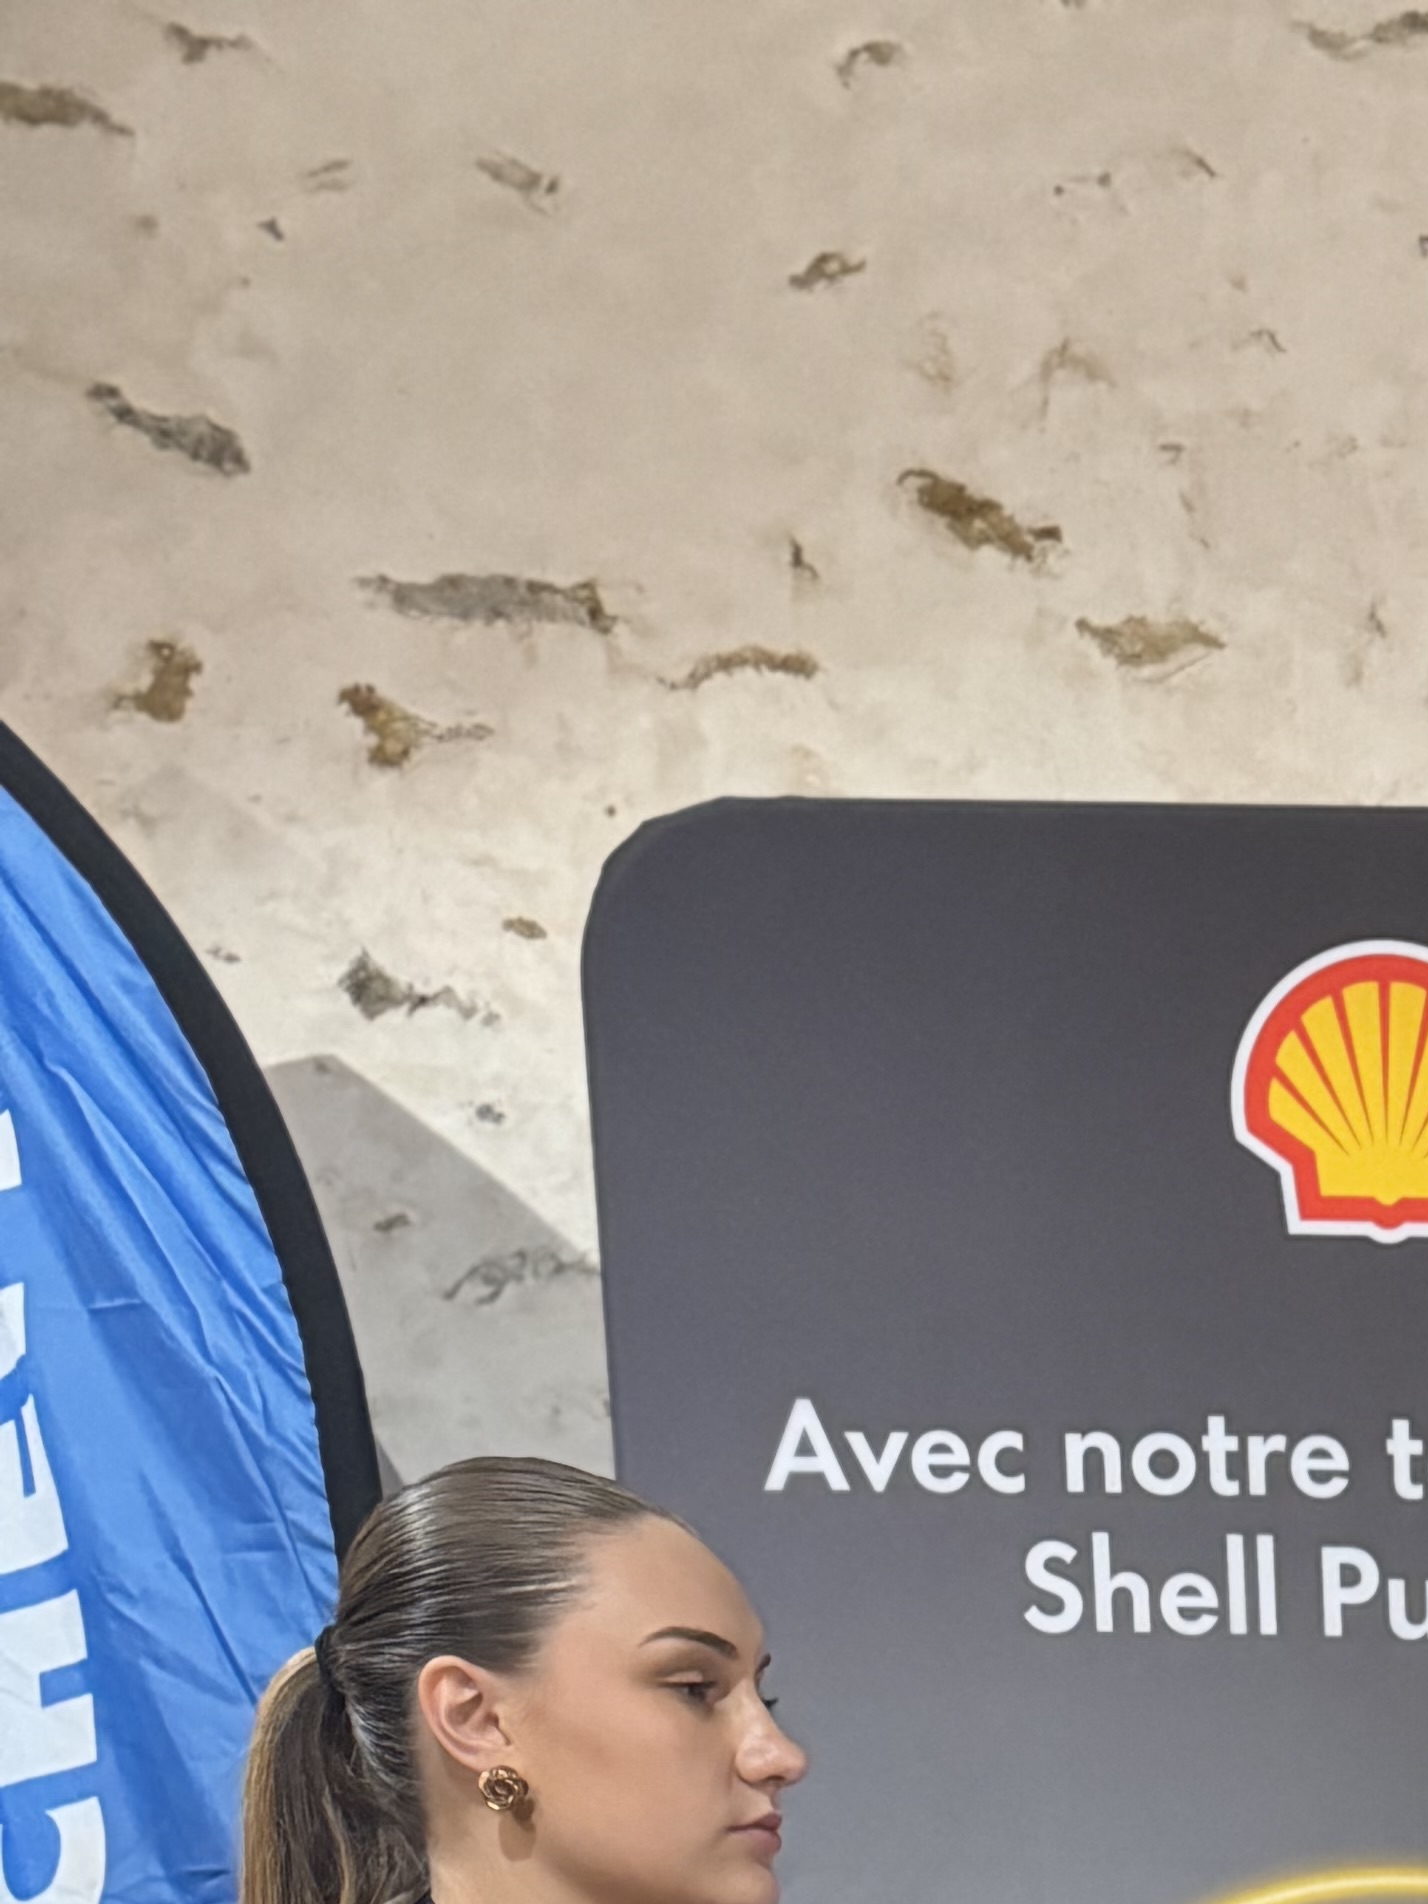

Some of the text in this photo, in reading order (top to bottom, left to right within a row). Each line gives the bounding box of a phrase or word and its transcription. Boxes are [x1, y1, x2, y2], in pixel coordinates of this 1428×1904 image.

[763, 1397, 1026, 1495] Avec
[1065, 1415, 1350, 1499] notre
[1023, 1531, 1278, 1636] Shell
